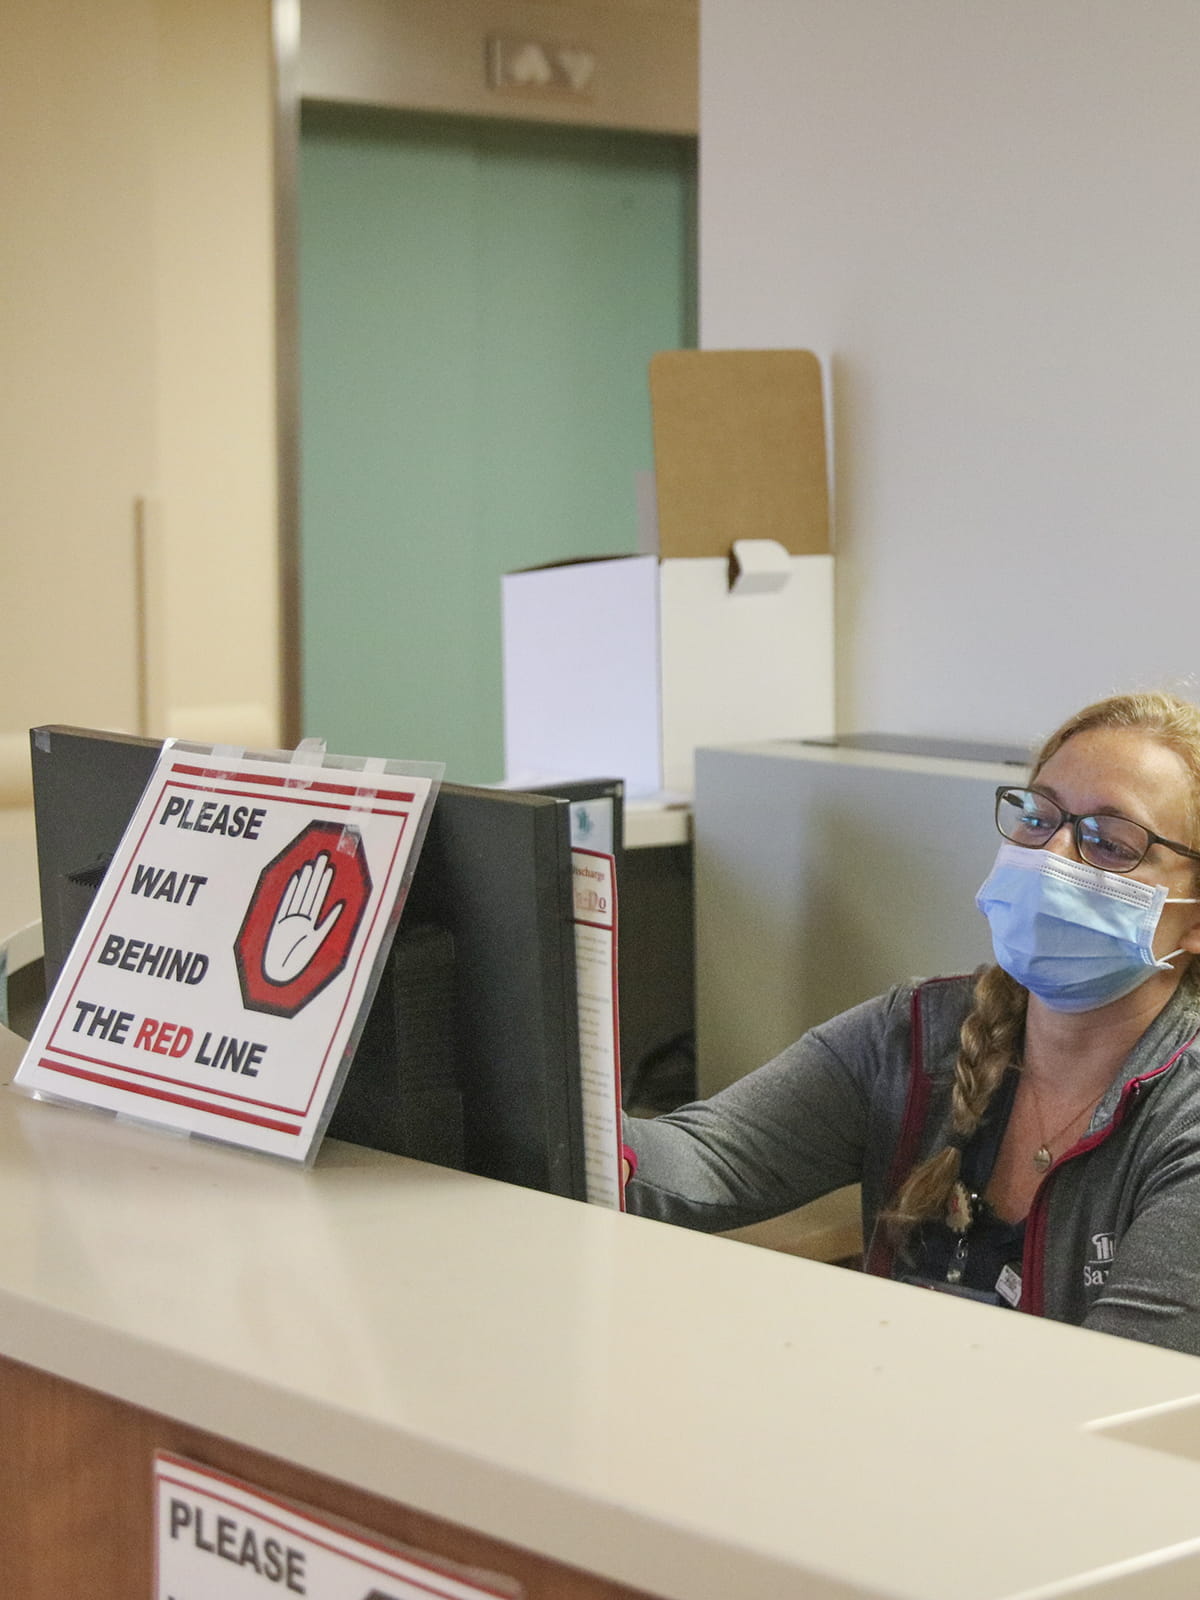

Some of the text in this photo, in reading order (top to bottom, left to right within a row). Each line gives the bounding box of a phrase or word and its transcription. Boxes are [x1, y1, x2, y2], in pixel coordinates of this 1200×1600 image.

[160, 796, 266, 840] PLEASE
[131, 864, 207, 906] WAIT
[97, 934, 209, 985] BEHIND
[72, 1000, 267, 1077] THE RED LINE
[170, 1499, 306, 1594] PLEASE
